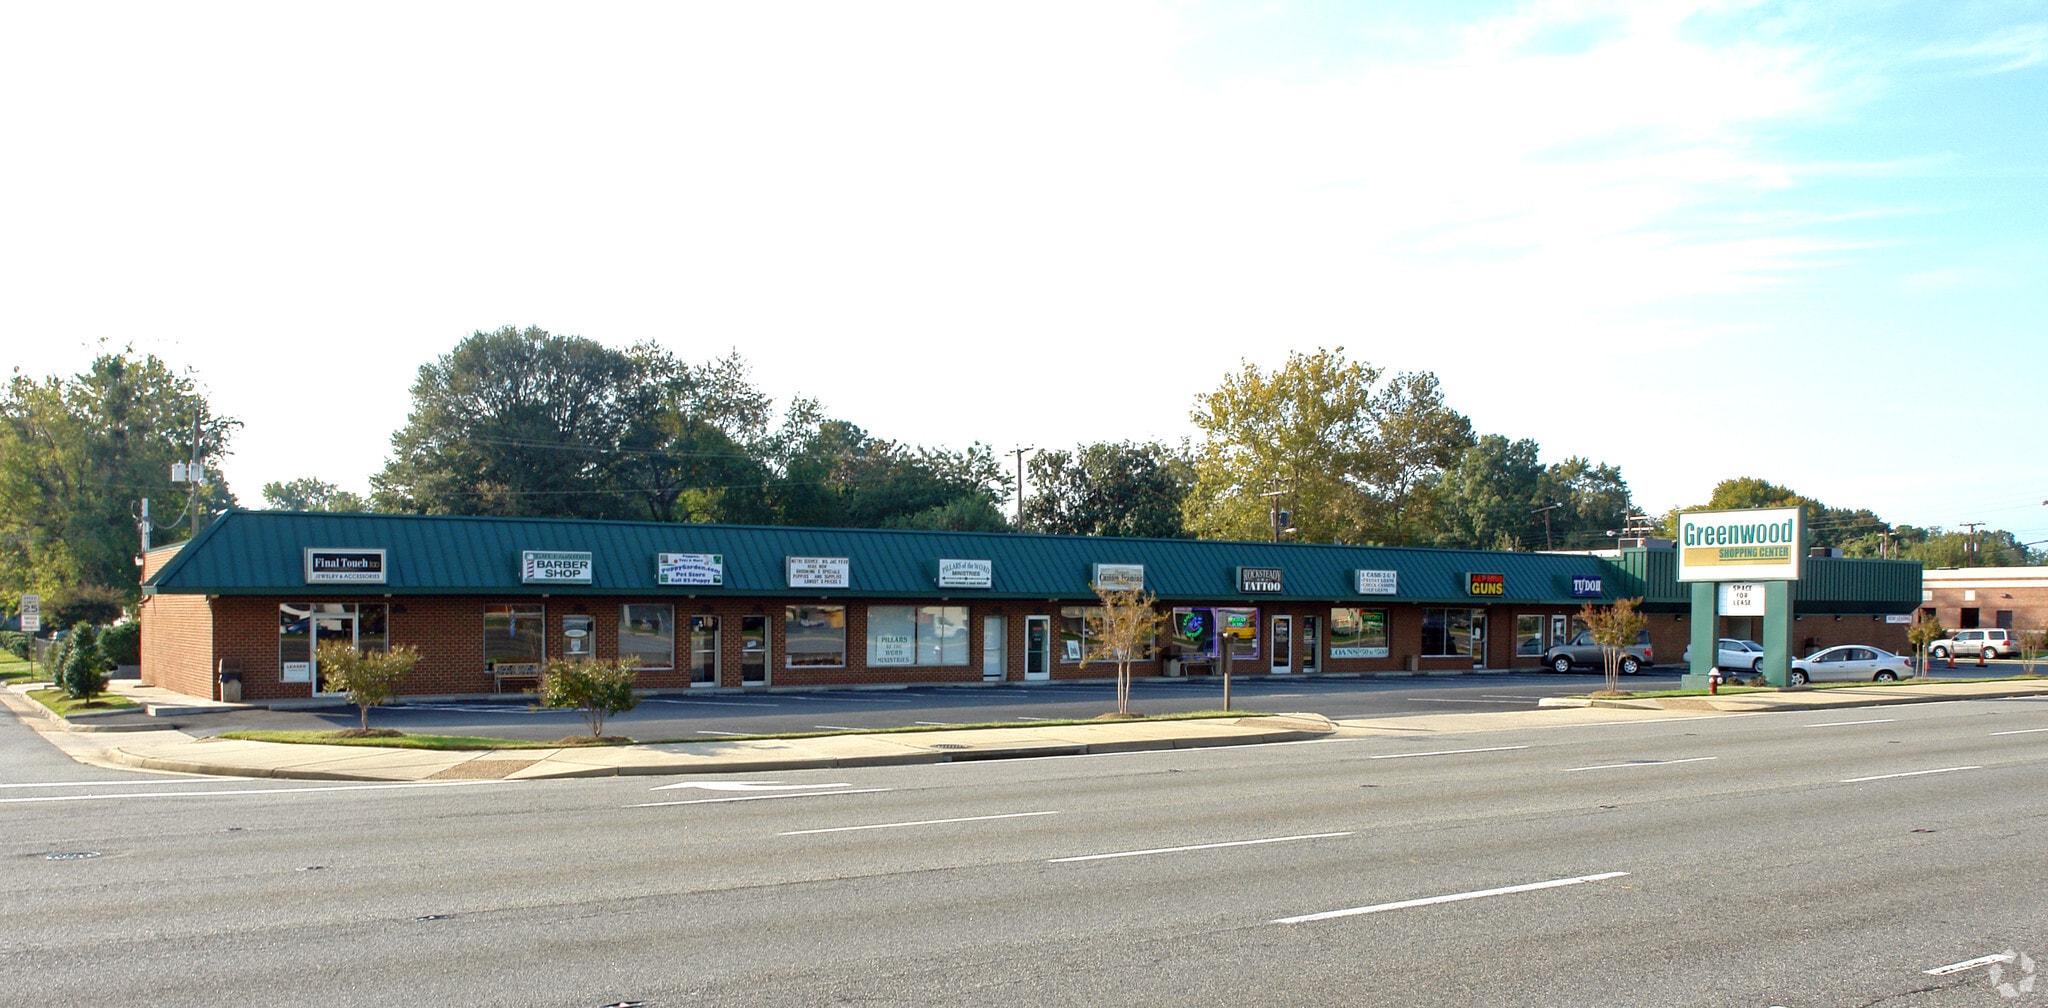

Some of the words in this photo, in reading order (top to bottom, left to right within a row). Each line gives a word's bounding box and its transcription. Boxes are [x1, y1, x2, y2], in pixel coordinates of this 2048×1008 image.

[1684, 518, 1793, 546] Greenwood
[1719, 548, 1758, 558] SHOPPING
[1759, 546, 1789, 557] CENTER
[315, 558, 339, 568] Final
[341, 558, 369, 568] Touch
[537, 560, 588, 569] BARBER
[545, 569, 581, 577] SHOP
[1244, 581, 1281, 591] TATTOO
[1472, 582, 1503, 594] GUNS
